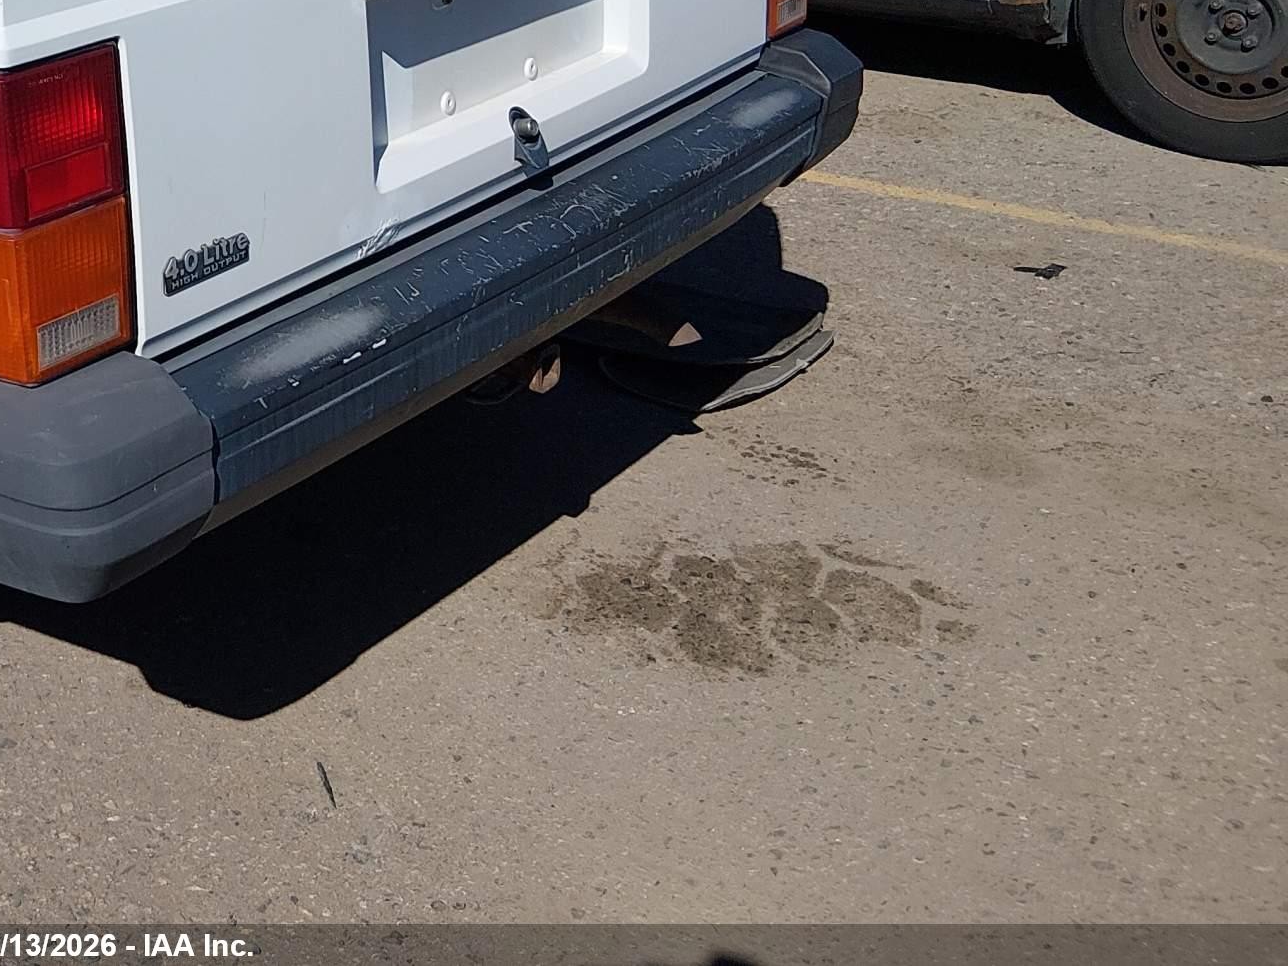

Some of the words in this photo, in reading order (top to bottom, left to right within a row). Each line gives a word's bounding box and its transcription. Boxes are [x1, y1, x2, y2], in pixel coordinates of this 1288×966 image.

[163, 248, 199, 281] 4.0
[200, 232, 249, 267] Litre
[171, 272, 199, 290] HIGH
[203, 251, 246, 274] OUTPUT
